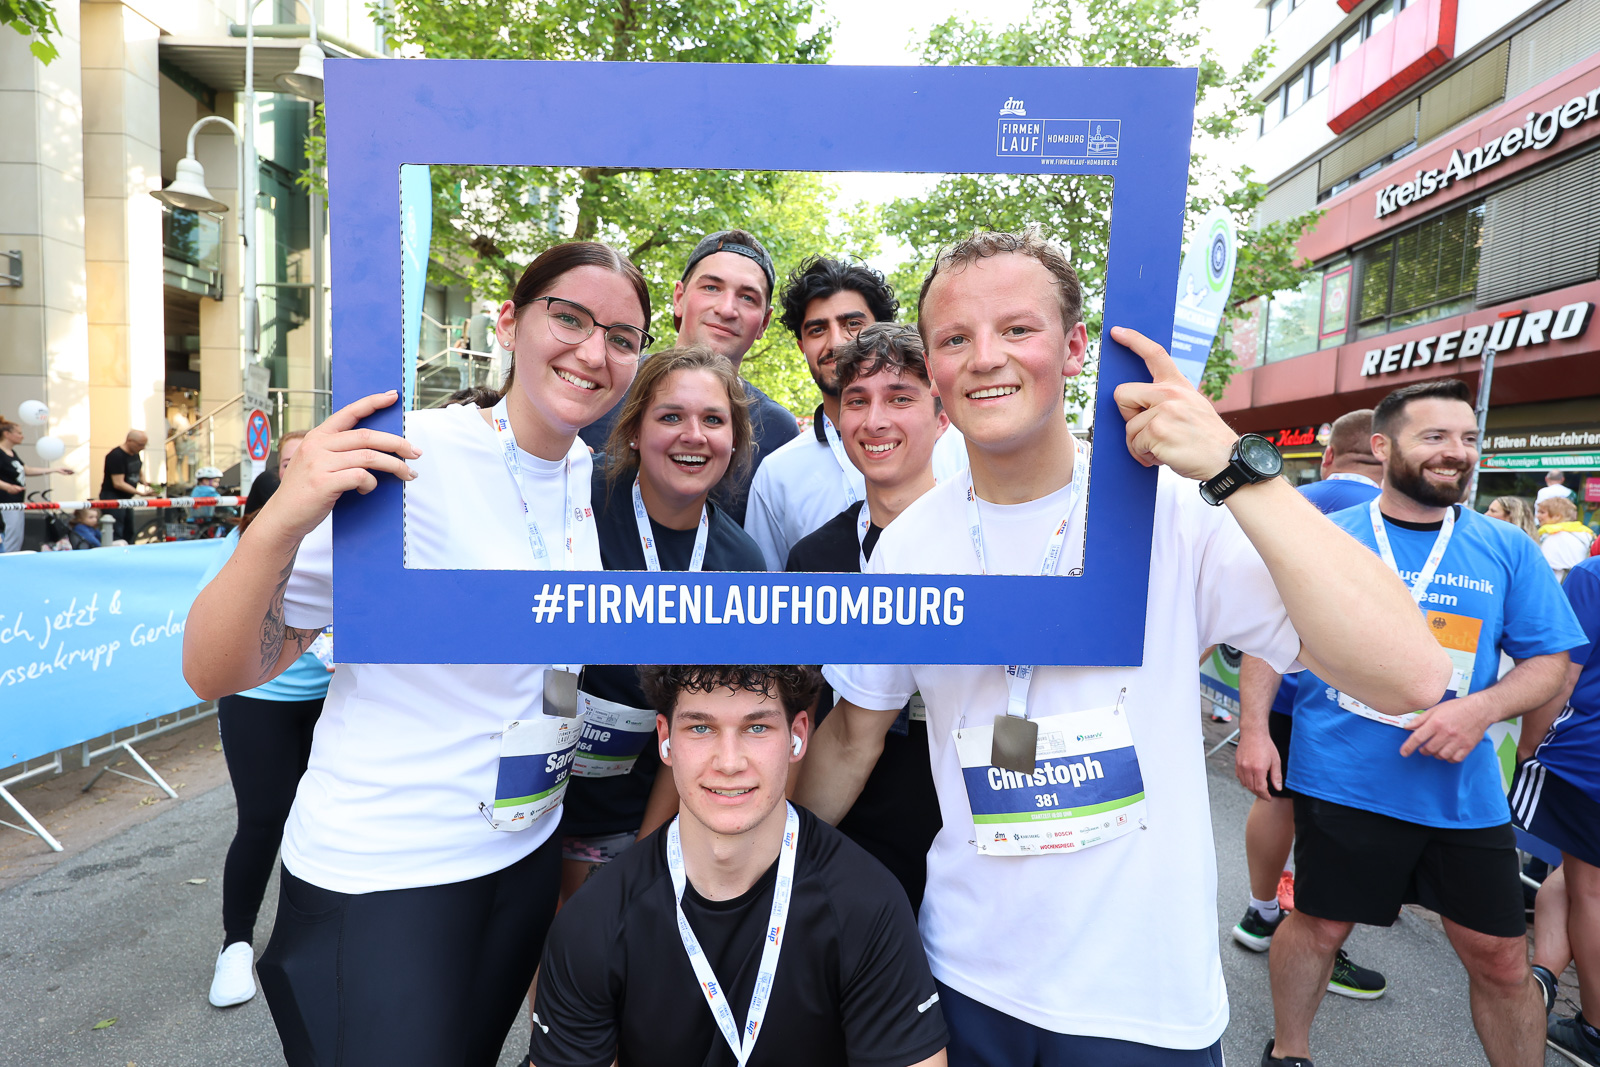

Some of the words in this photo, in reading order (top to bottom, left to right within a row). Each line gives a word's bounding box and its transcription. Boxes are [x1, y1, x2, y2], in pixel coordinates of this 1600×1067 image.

[1003, 97, 1024, 110] dm
[1002, 123, 1040, 134] FIRMEN
[1001, 136, 1039, 152] LAUF
[1047, 134, 1085, 144] HOMBURG
[1374, 86, 1600, 219] Kreis-Anzeiger
[1400, 569, 1494, 595] ugnklinik
[531, 583, 966, 626] #FIRMENLAUFHOMBURG
[1409, 587, 1458, 606] eam
[38, 592, 99, 650] jetzt
[580, 722, 611, 743] line
[1034, 792, 1059, 808] 381
[1054, 830, 1073, 838] BOSCH
